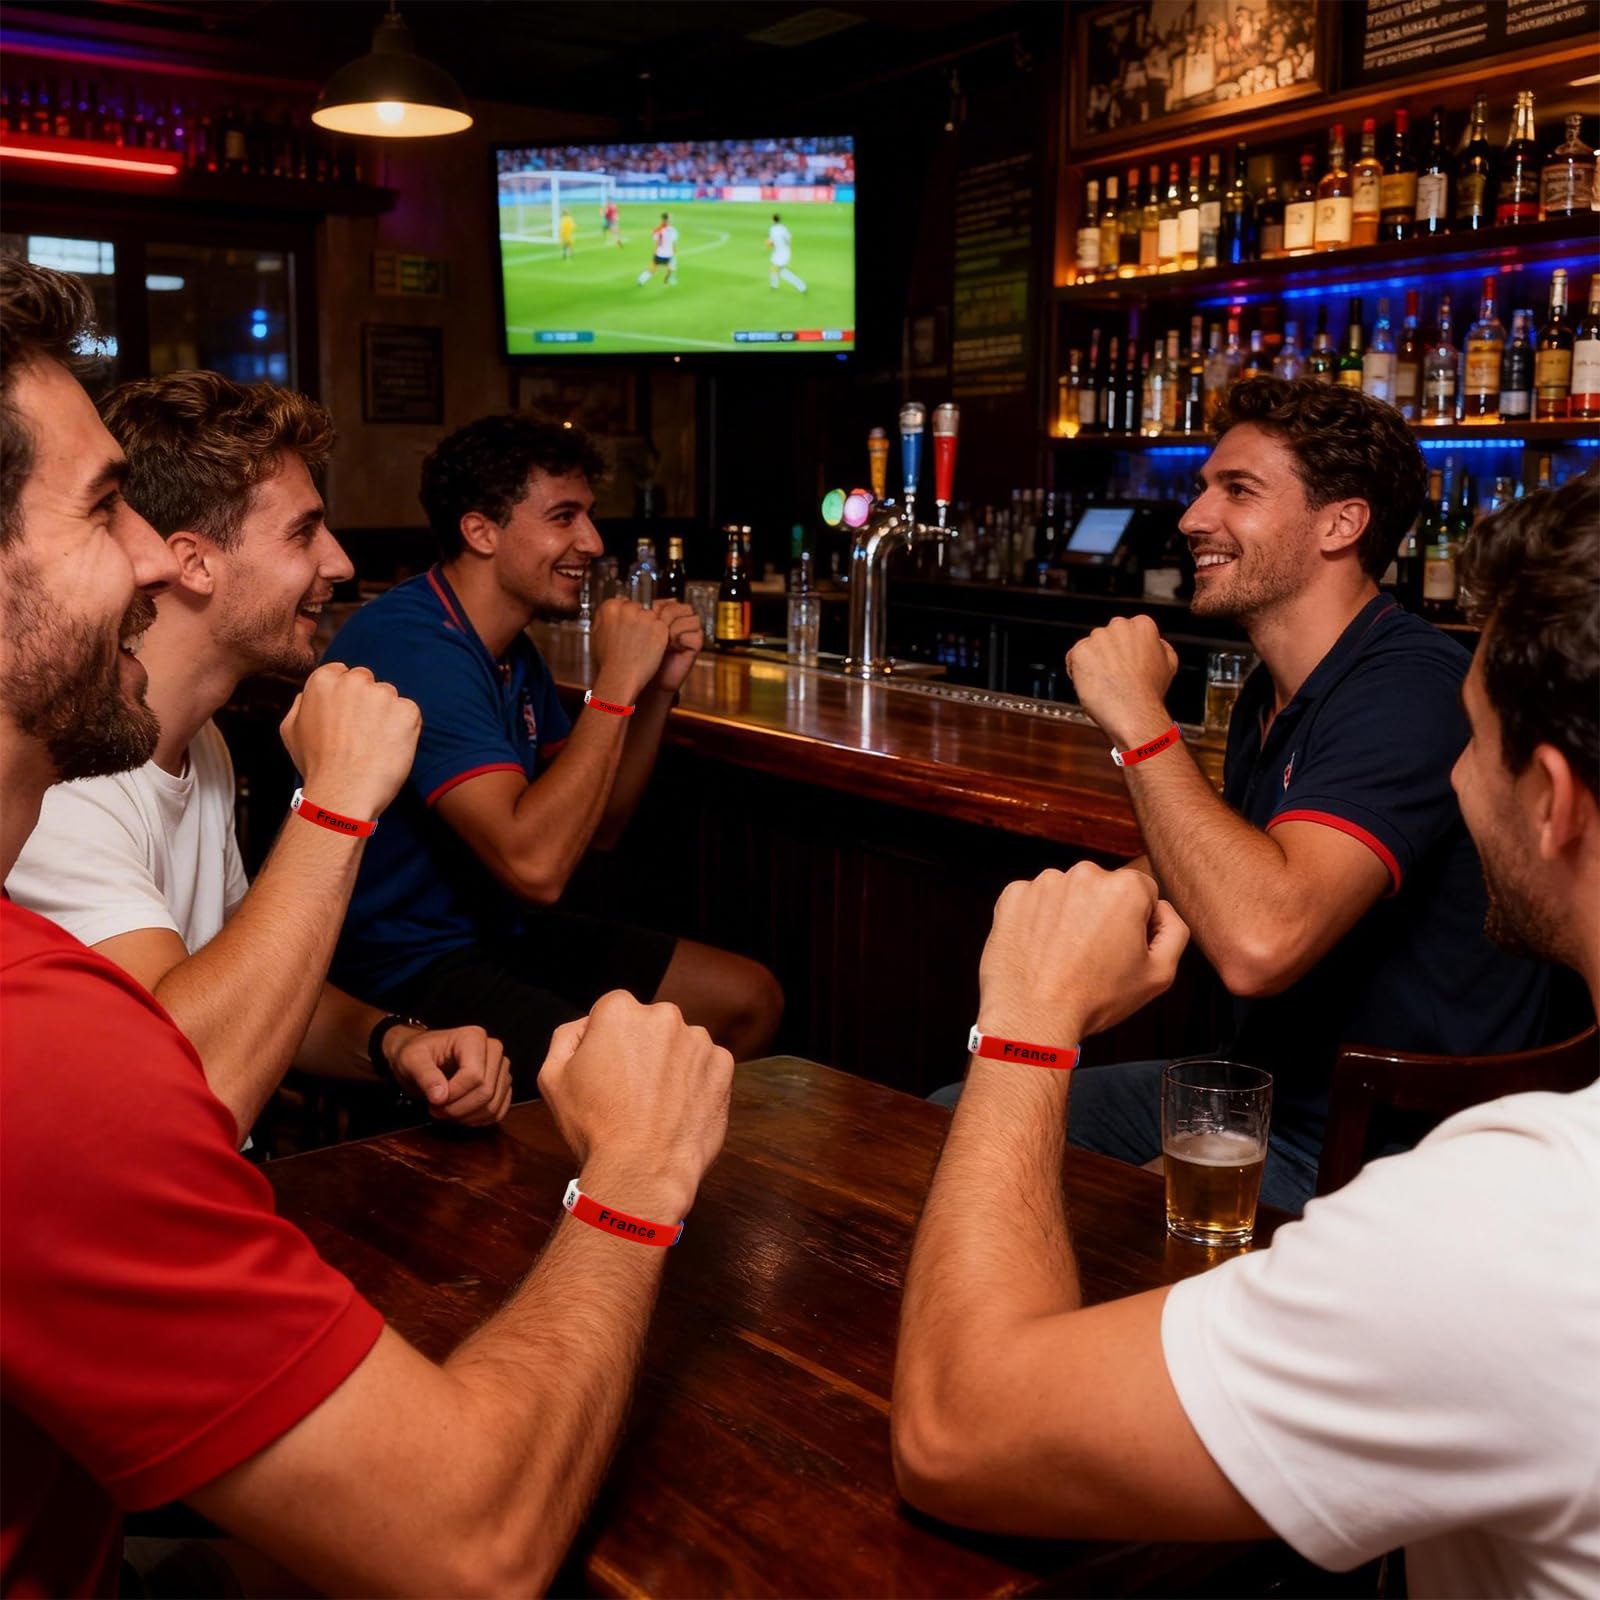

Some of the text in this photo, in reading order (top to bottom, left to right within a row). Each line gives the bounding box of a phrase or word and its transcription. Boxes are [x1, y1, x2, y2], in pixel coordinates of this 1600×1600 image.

[1136, 736, 1170, 757] France
[316, 810, 359, 832] France
[1003, 1043, 1057, 1063] France
[599, 1209, 656, 1239] France
